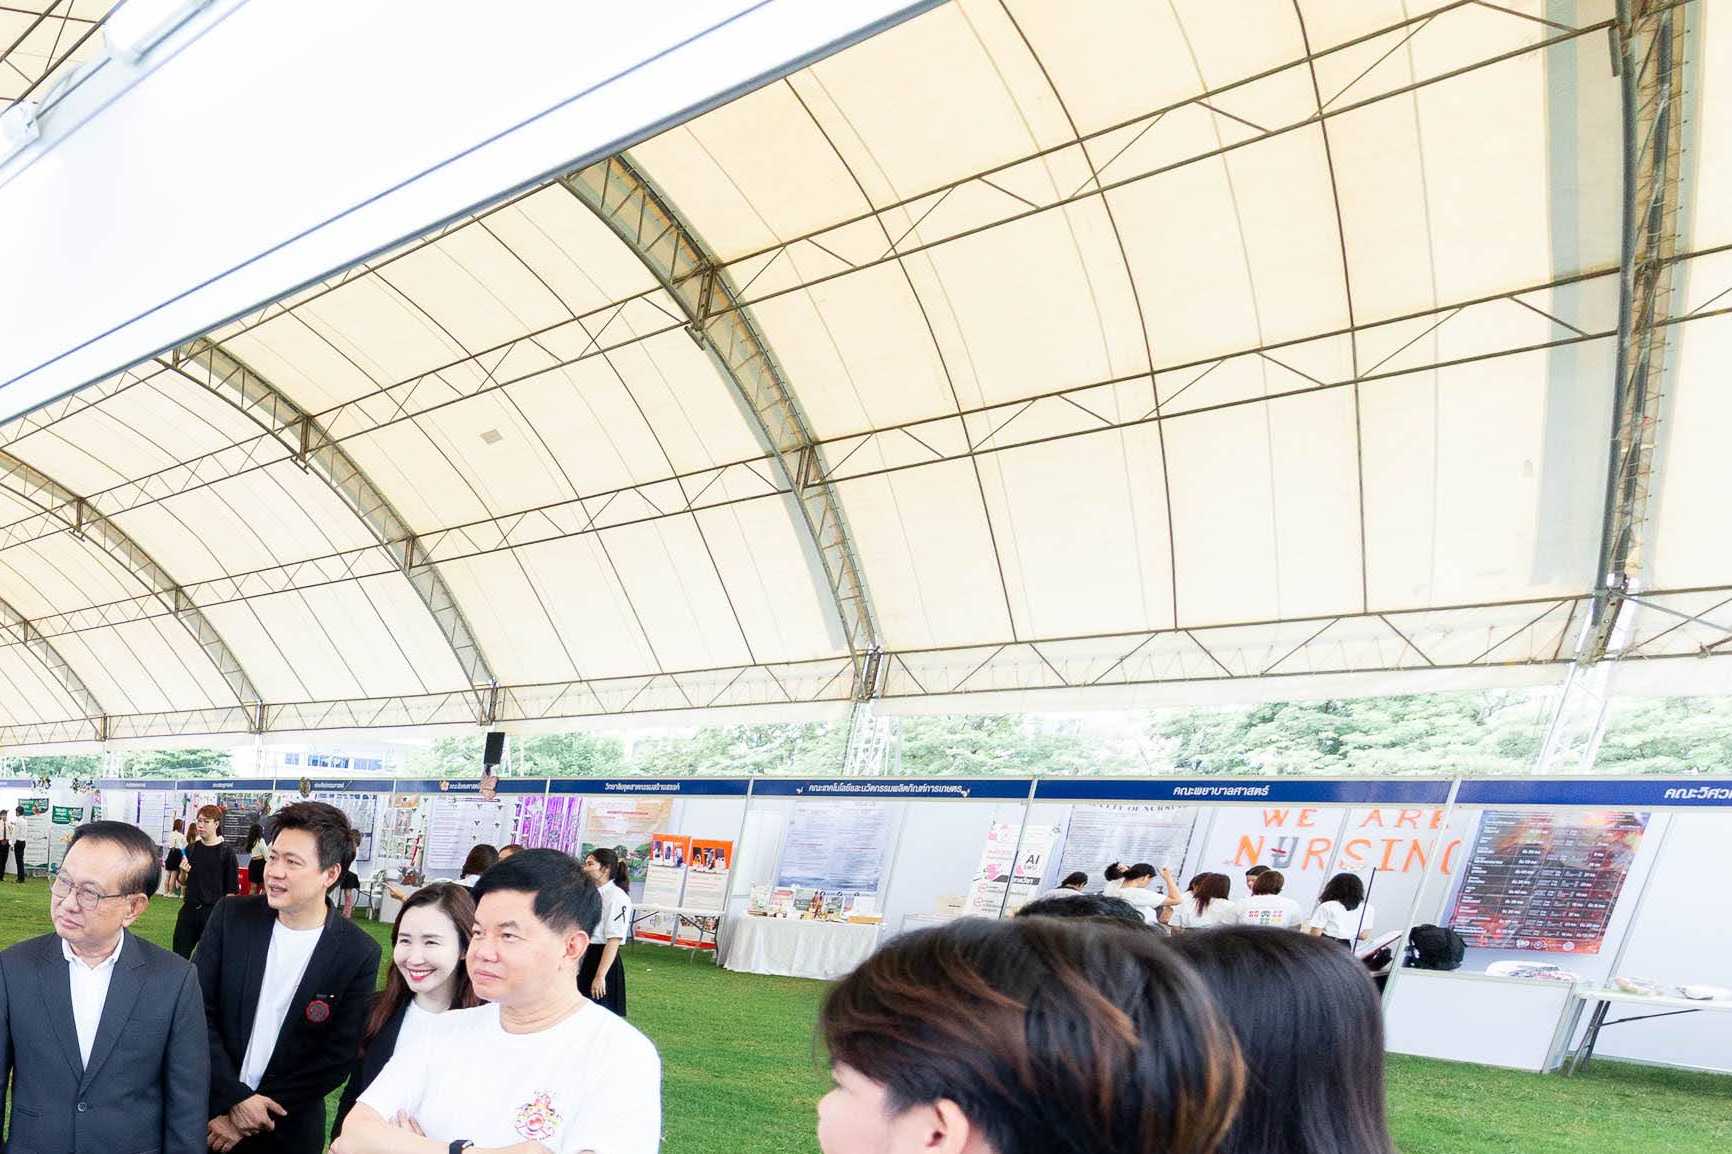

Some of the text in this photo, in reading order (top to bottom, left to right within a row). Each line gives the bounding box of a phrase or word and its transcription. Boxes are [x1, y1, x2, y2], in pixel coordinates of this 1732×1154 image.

[1172, 784, 1271, 797] คณะพยาบาลศาสตร์
[1664, 786, 1732, 800] คณะวิศว
[1262, 808, 1453, 830] WE ARE
[1025, 854, 1041, 865] AI
